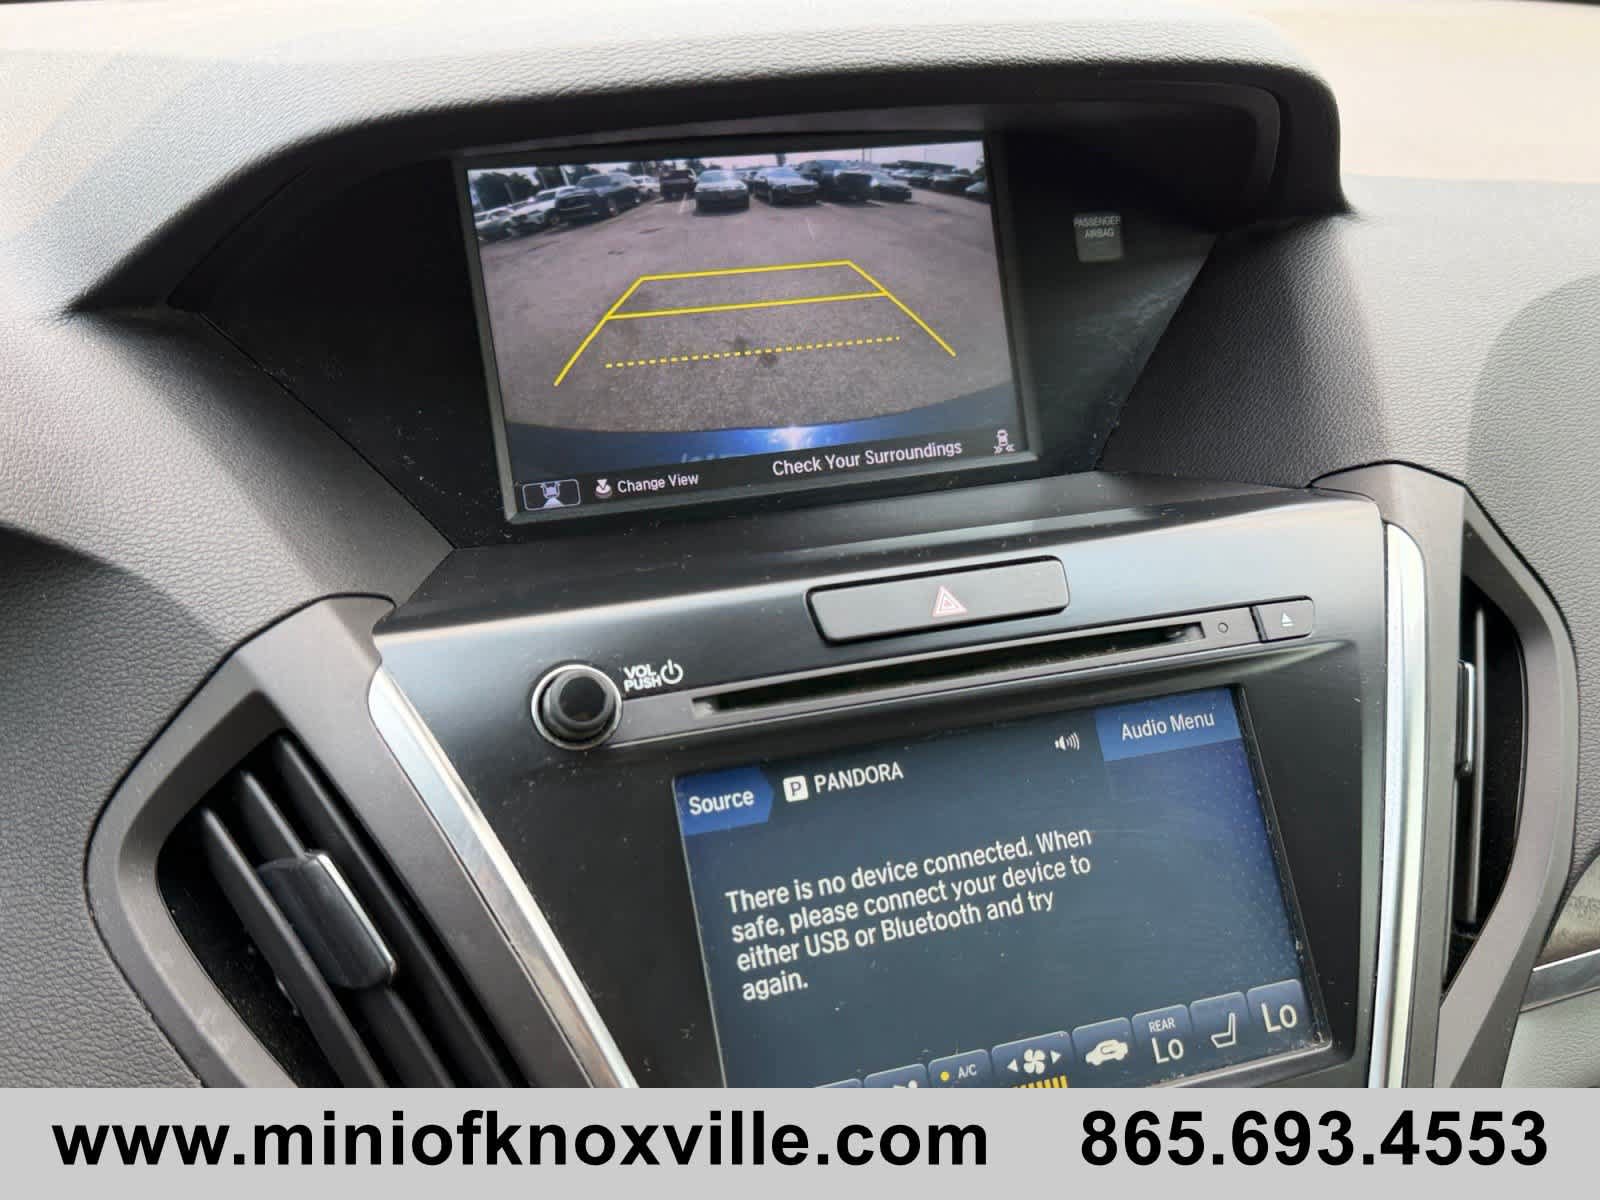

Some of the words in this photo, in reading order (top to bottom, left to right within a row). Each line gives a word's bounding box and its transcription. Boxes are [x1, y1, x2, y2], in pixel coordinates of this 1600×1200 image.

[772, 455, 822, 477] Check
[825, 453, 860, 469] Your
[865, 440, 963, 465] Surroundings
[617, 478, 665, 494] Change
[668, 473, 699, 487] View
[623, 664, 657, 679] VOL
[624, 675, 662, 692] PUSH
[1120, 718, 1168, 742] Audio
[1170, 709, 1215, 733] Menu
[814, 760, 904, 794] PANDORA
[688, 786, 755, 817] Source
[725, 886, 790, 914] There
[794, 879, 813, 901] is
[818, 874, 846, 896] no
[851, 860, 919, 890] device
[923, 837, 1033, 876] connected.
[1036, 828, 1092, 854] When
[731, 917, 785, 943] safe,
[789, 899, 858, 933] please
[863, 880, 947, 916] connect
[951, 872, 997, 901] your
[1002, 859, 1066, 888] device
[1070, 854, 1091, 874] to
[737, 940, 800, 971] either
[804, 931, 850, 958] USB
[854, 927, 877, 948] or
[881, 903, 982, 942] Bluetooth
[986, 893, 1024, 921] and
[1028, 889, 1054, 912] try
[742, 969, 809, 1001] again.
[1148, 1017, 1176, 1033] REAR
[1261, 1003, 1298, 1034] Lo
[1151, 1035, 1185, 1064] Lo
[957, 1064, 978, 1080] A/C
